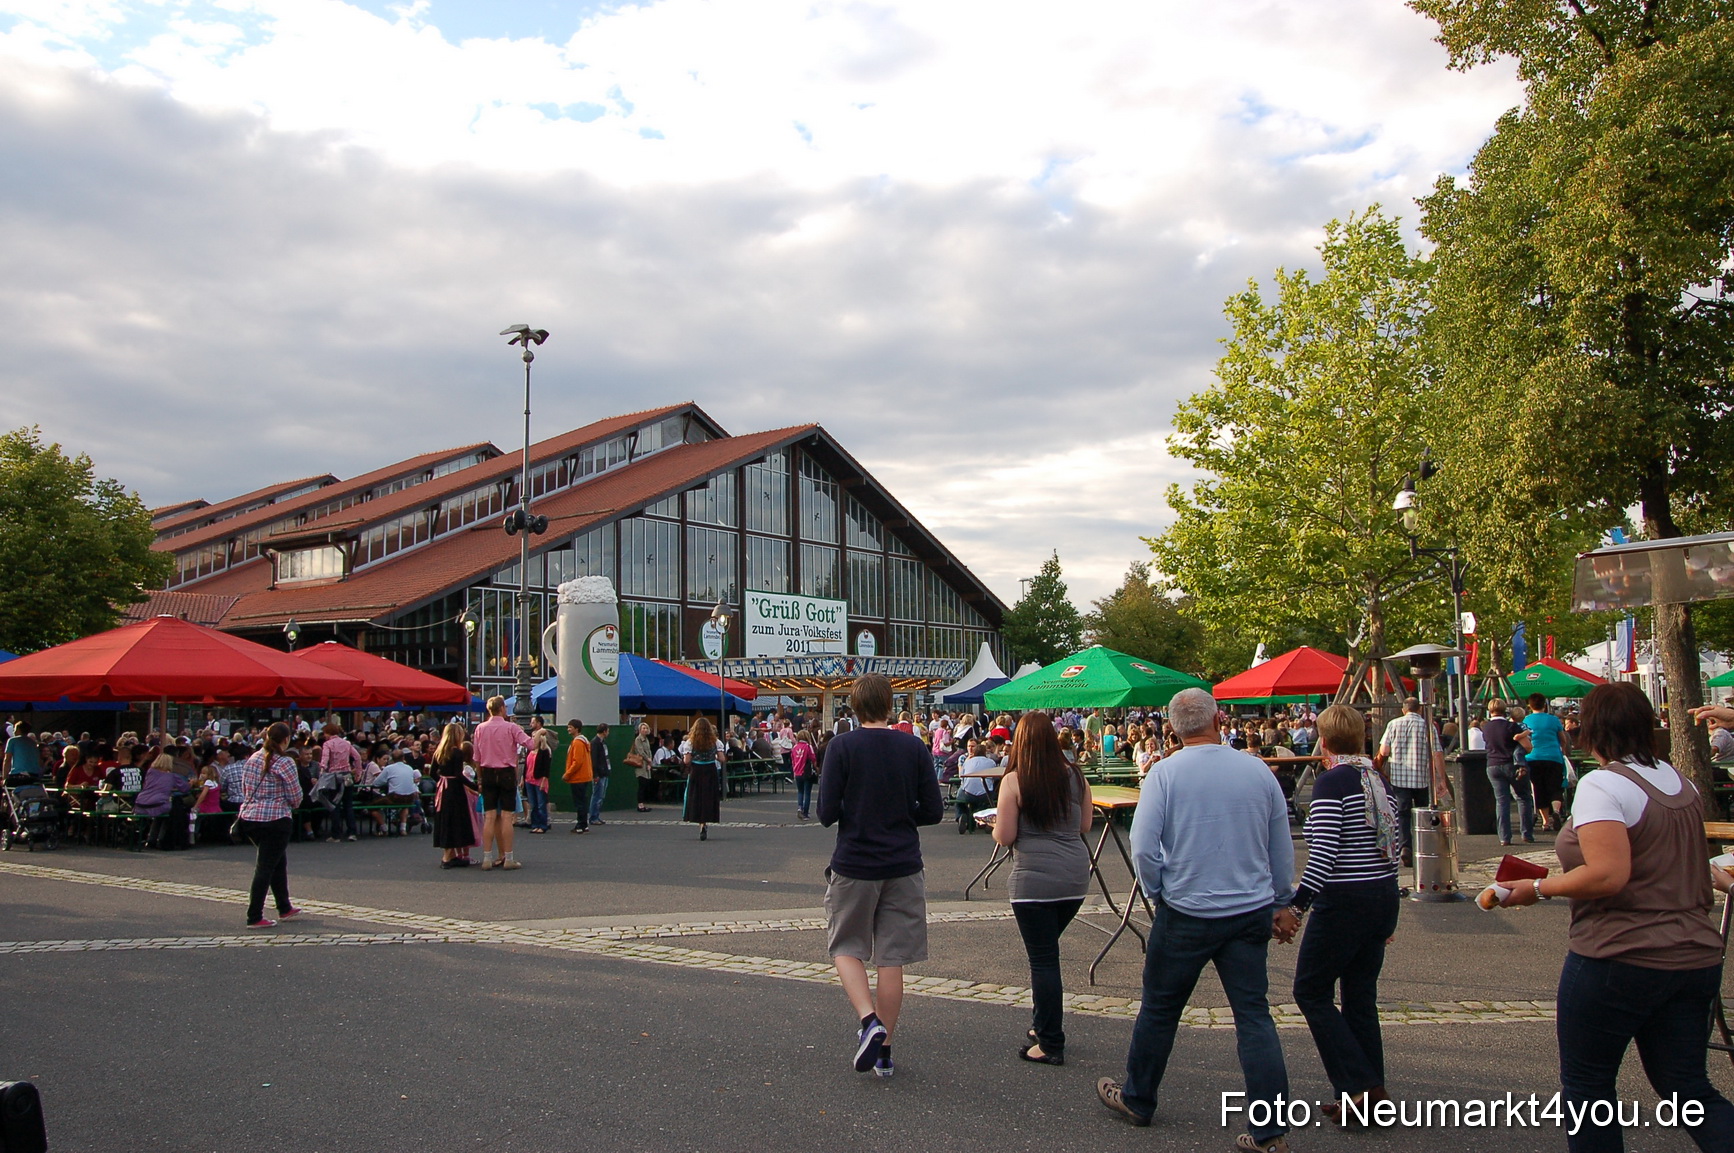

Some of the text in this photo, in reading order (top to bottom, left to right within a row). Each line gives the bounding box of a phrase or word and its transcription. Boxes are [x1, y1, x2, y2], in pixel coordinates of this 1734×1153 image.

[752, 623, 842, 639] zum Jura-Volksfest
[786, 639, 810, 653] 2011
[867, 659, 946, 677] Liebermann
